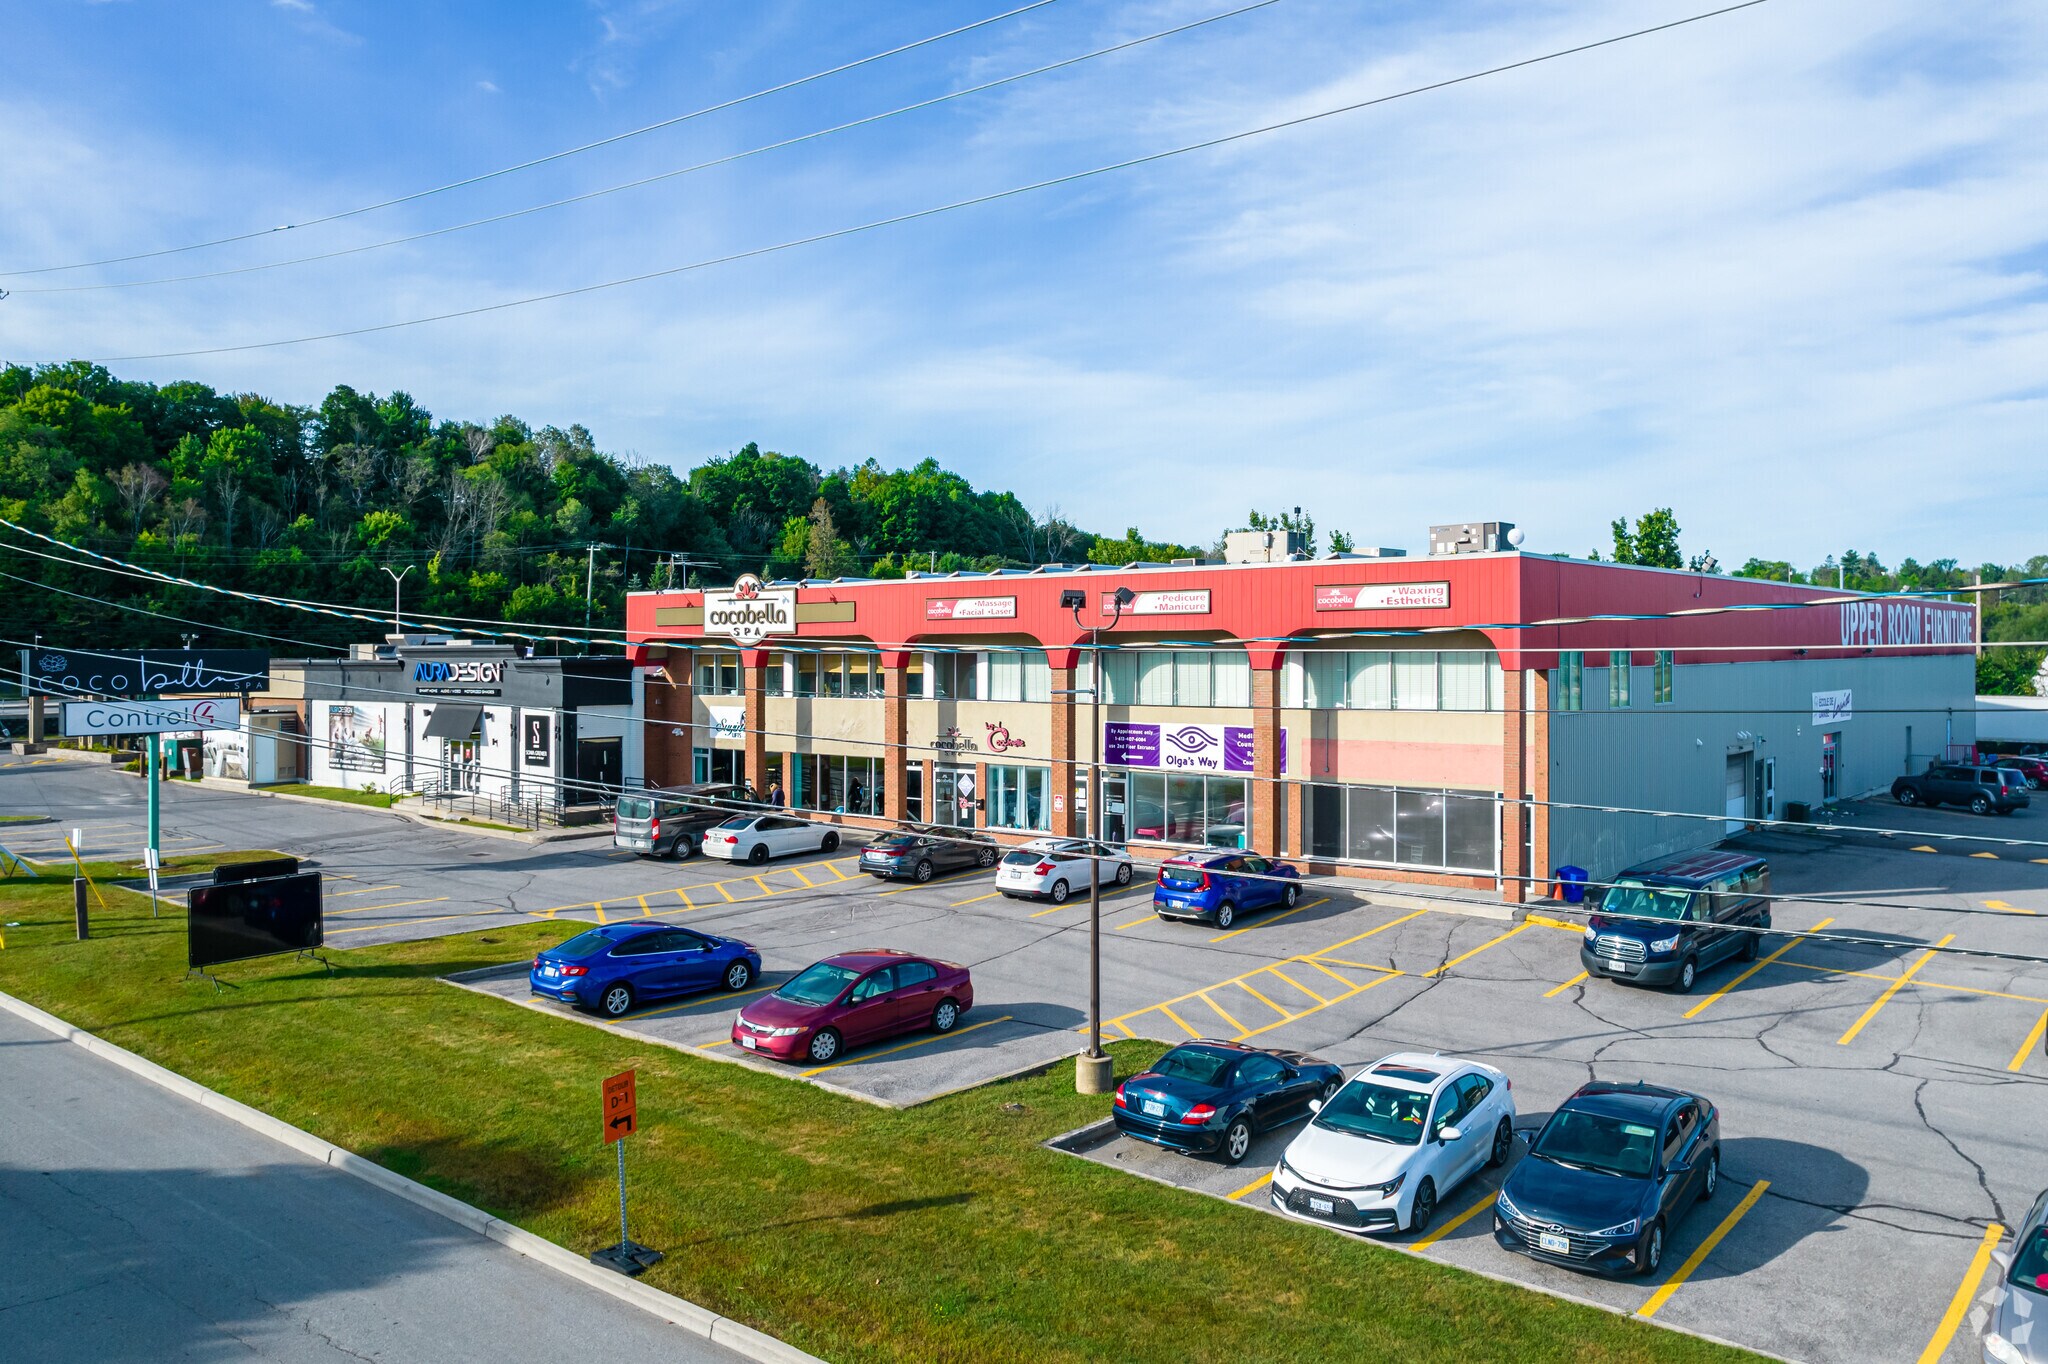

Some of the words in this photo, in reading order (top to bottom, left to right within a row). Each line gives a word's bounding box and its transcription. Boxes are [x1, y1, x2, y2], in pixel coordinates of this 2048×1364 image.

[1398, 586, 1444, 596] Waxing
[1162, 594, 1206, 602] Pedicure
[1318, 596, 1352, 604] cocobella
[1386, 596, 1444, 605] Esthetics
[977, 600, 1013, 609] Massage
[1159, 603, 1206, 611] Manicure
[710, 603, 786, 625] cocobella
[962, 608, 984, 616] Facial
[1840, 602, 1882, 646] UPPER
[1887, 603, 1921, 645] ROOM
[1924, 607, 1972, 645] FURNITURE
[733, 627, 761, 636] SPA
[234, 681, 263, 690] SPA
[1166, 755, 1195, 768] Olga's
[1198, 756, 1218, 770] Way
